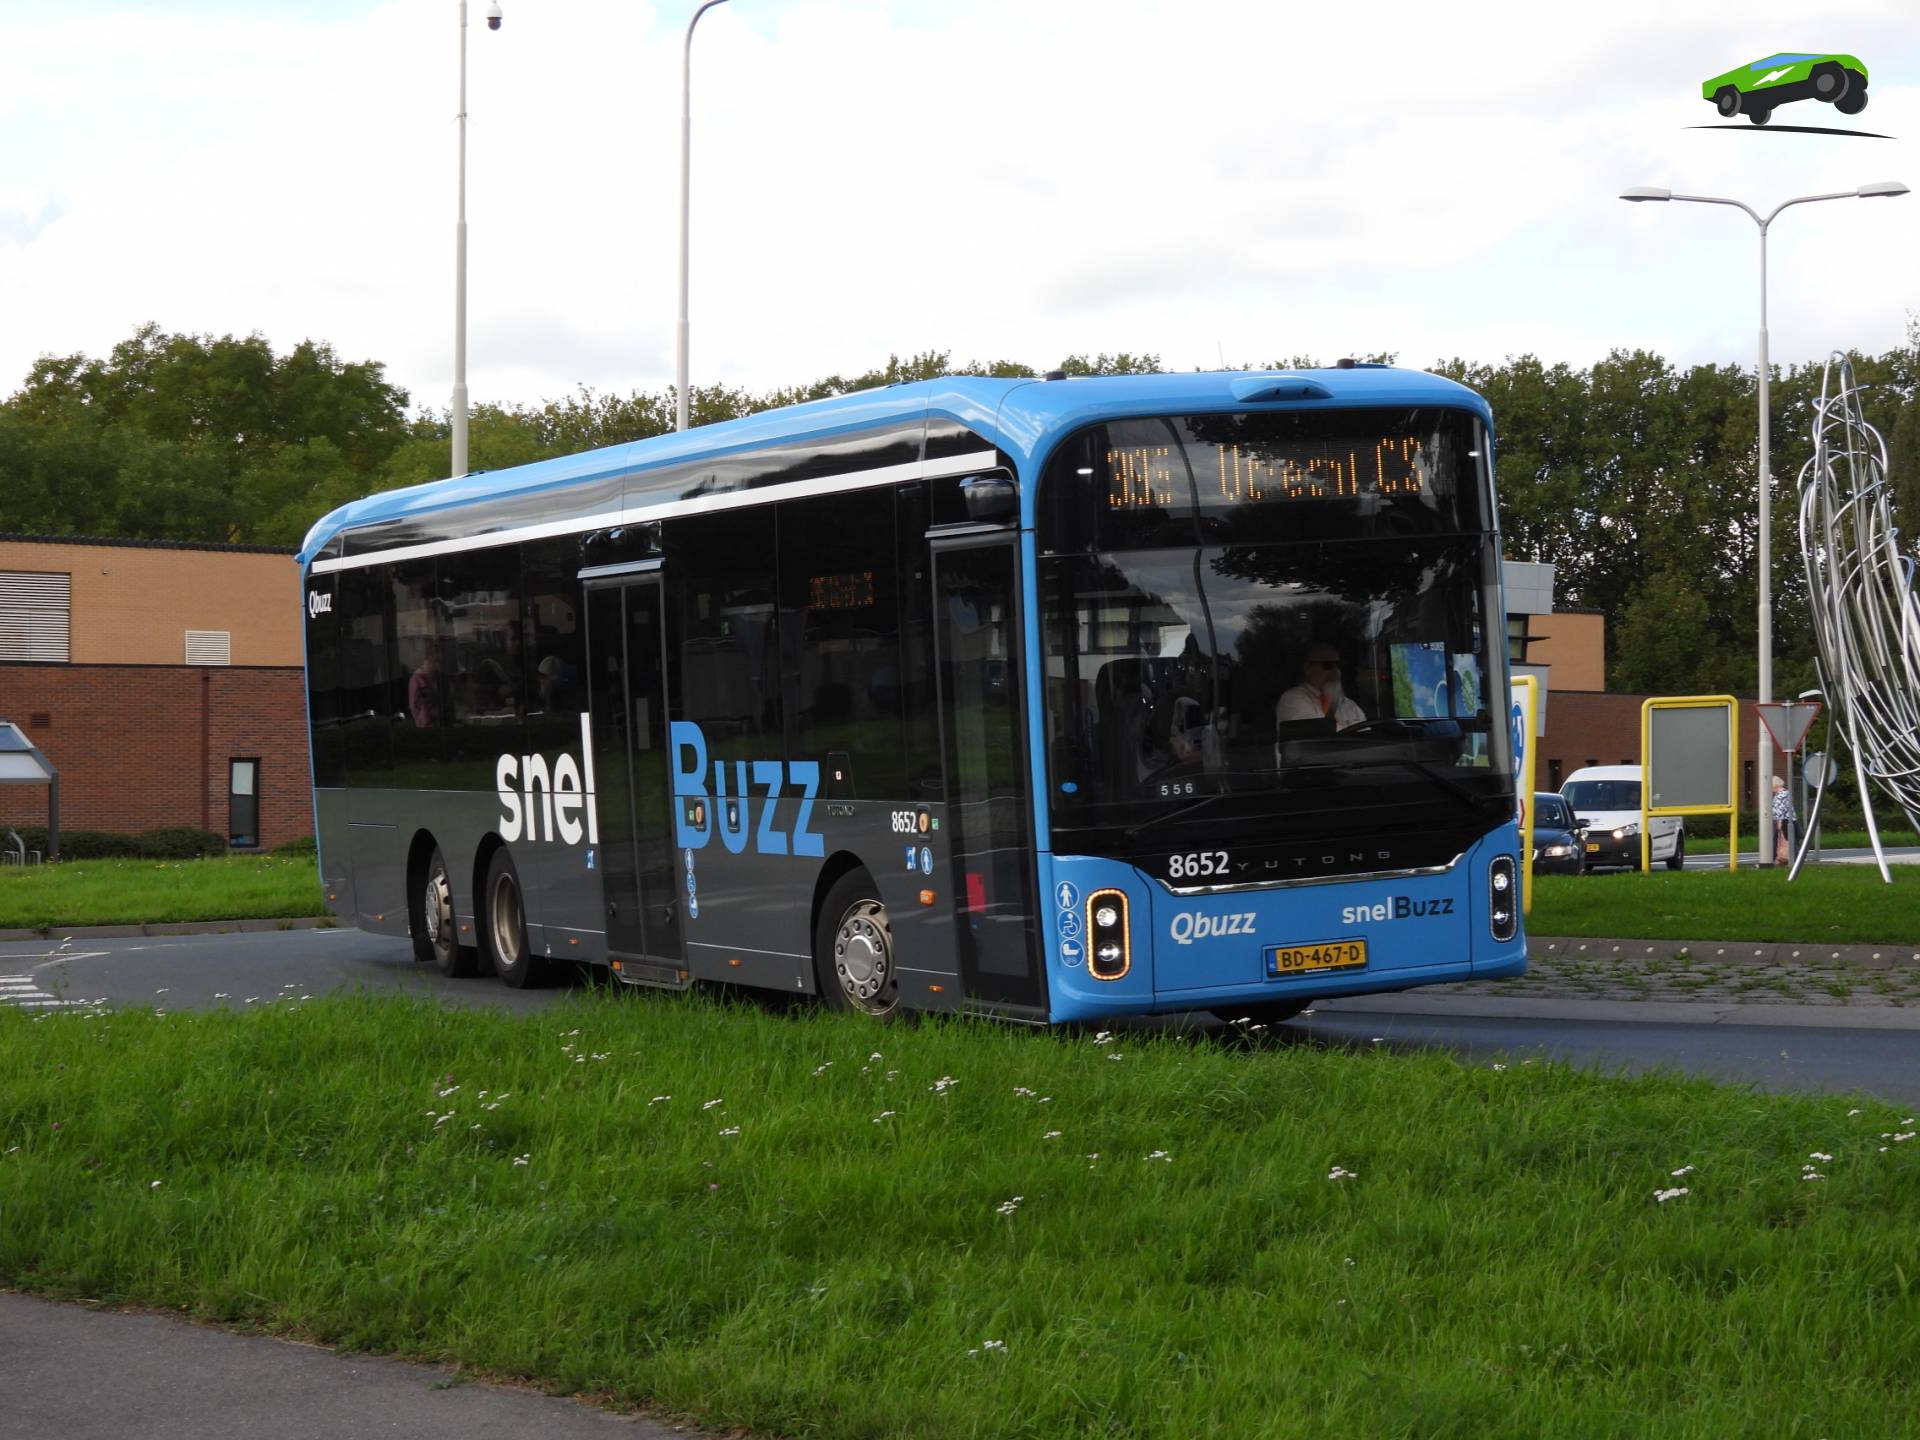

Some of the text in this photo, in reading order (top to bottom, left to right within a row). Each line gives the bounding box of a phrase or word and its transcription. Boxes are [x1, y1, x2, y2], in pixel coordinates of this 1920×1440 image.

[309, 590, 332, 619] Qbuzz
[496, 712, 599, 846] snel
[670, 721, 825, 857] Buzz
[892, 811, 918, 833] 8652
[1168, 851, 1231, 878] 8652
[1235, 850, 1391, 871] YUTONG
[1342, 896, 1455, 924] snelBuzz
[1170, 911, 1257, 945] Qbuzz
[1281, 944, 1360, 968] BD-467-D
